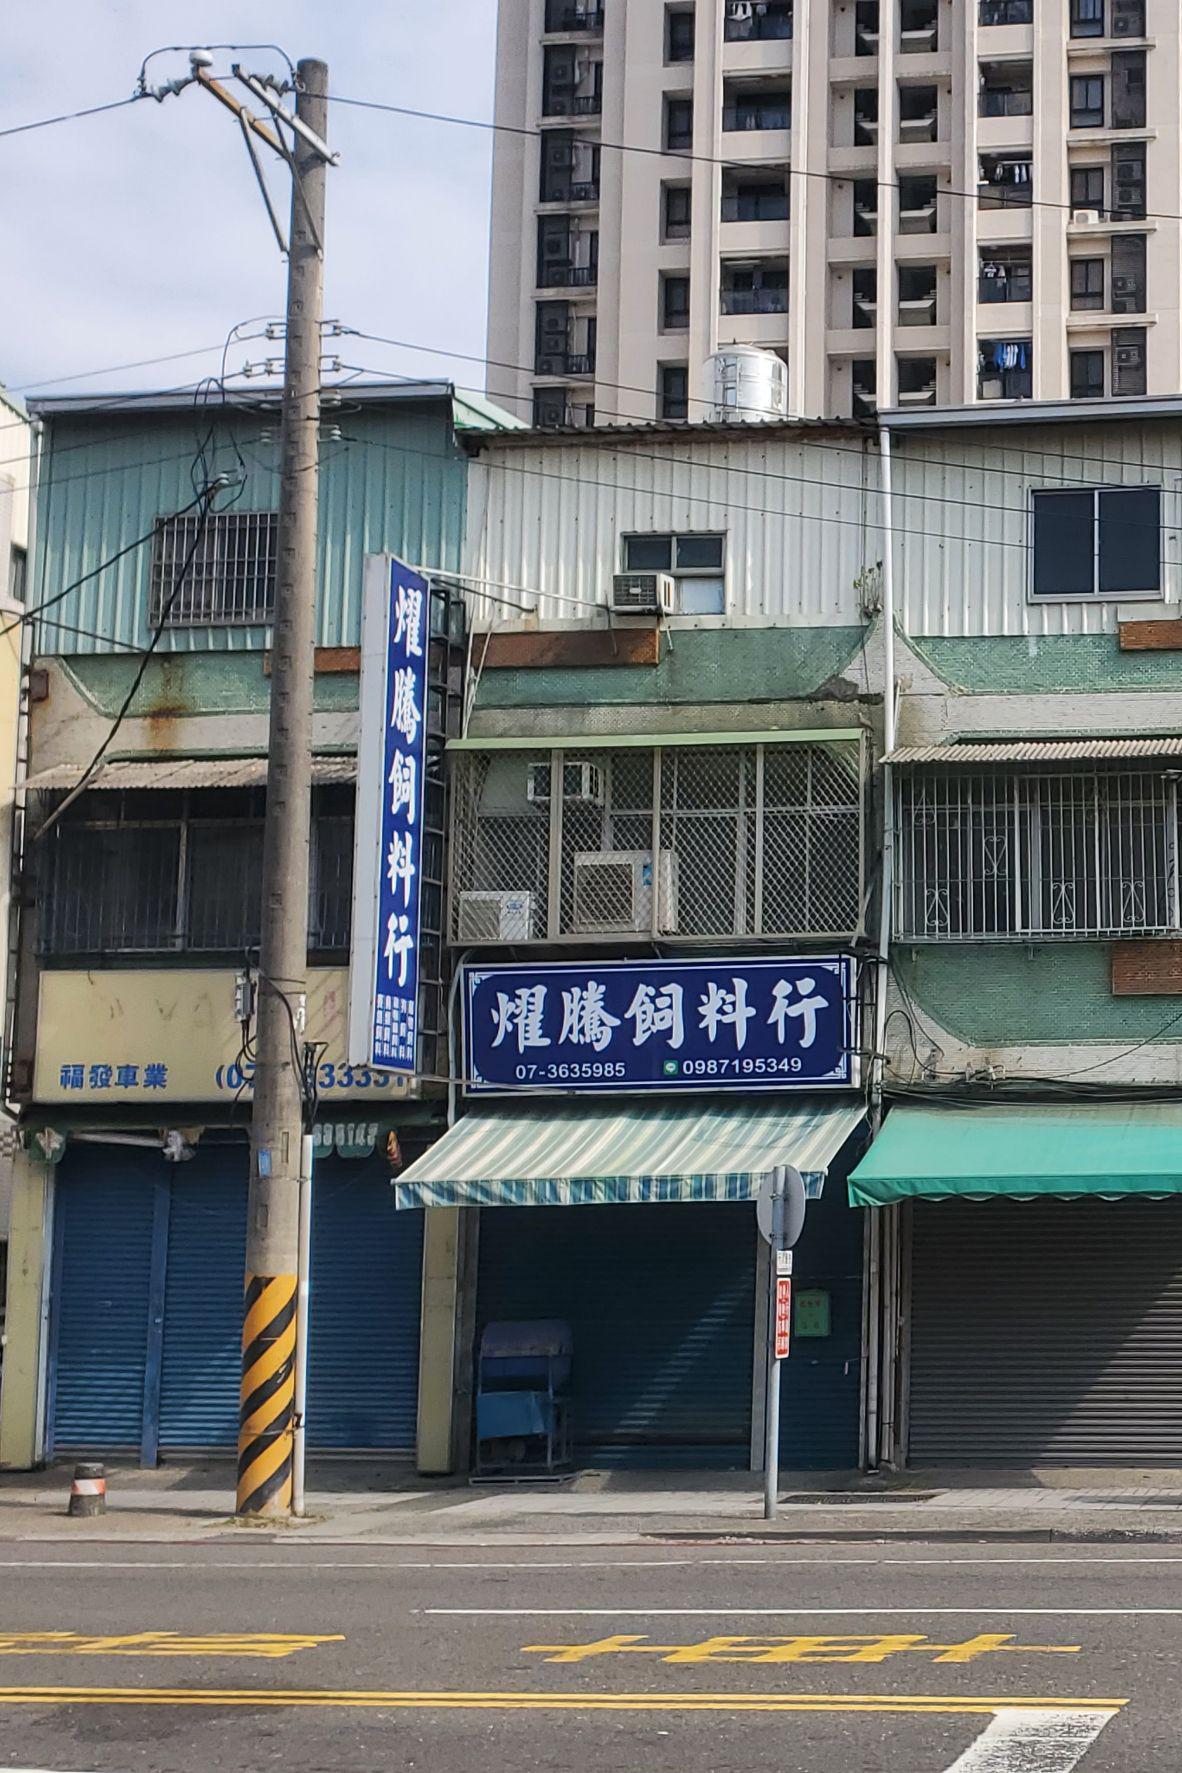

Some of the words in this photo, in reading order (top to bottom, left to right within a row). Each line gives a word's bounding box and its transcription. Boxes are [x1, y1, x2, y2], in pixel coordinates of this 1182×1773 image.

[490, 976, 830, 1055] 燿騰飼料行
[59, 1063, 169, 1090] 福發車業
[515, 1062, 626, 1079] 07-3635985
[682, 1057, 802, 1075] 0987195349
